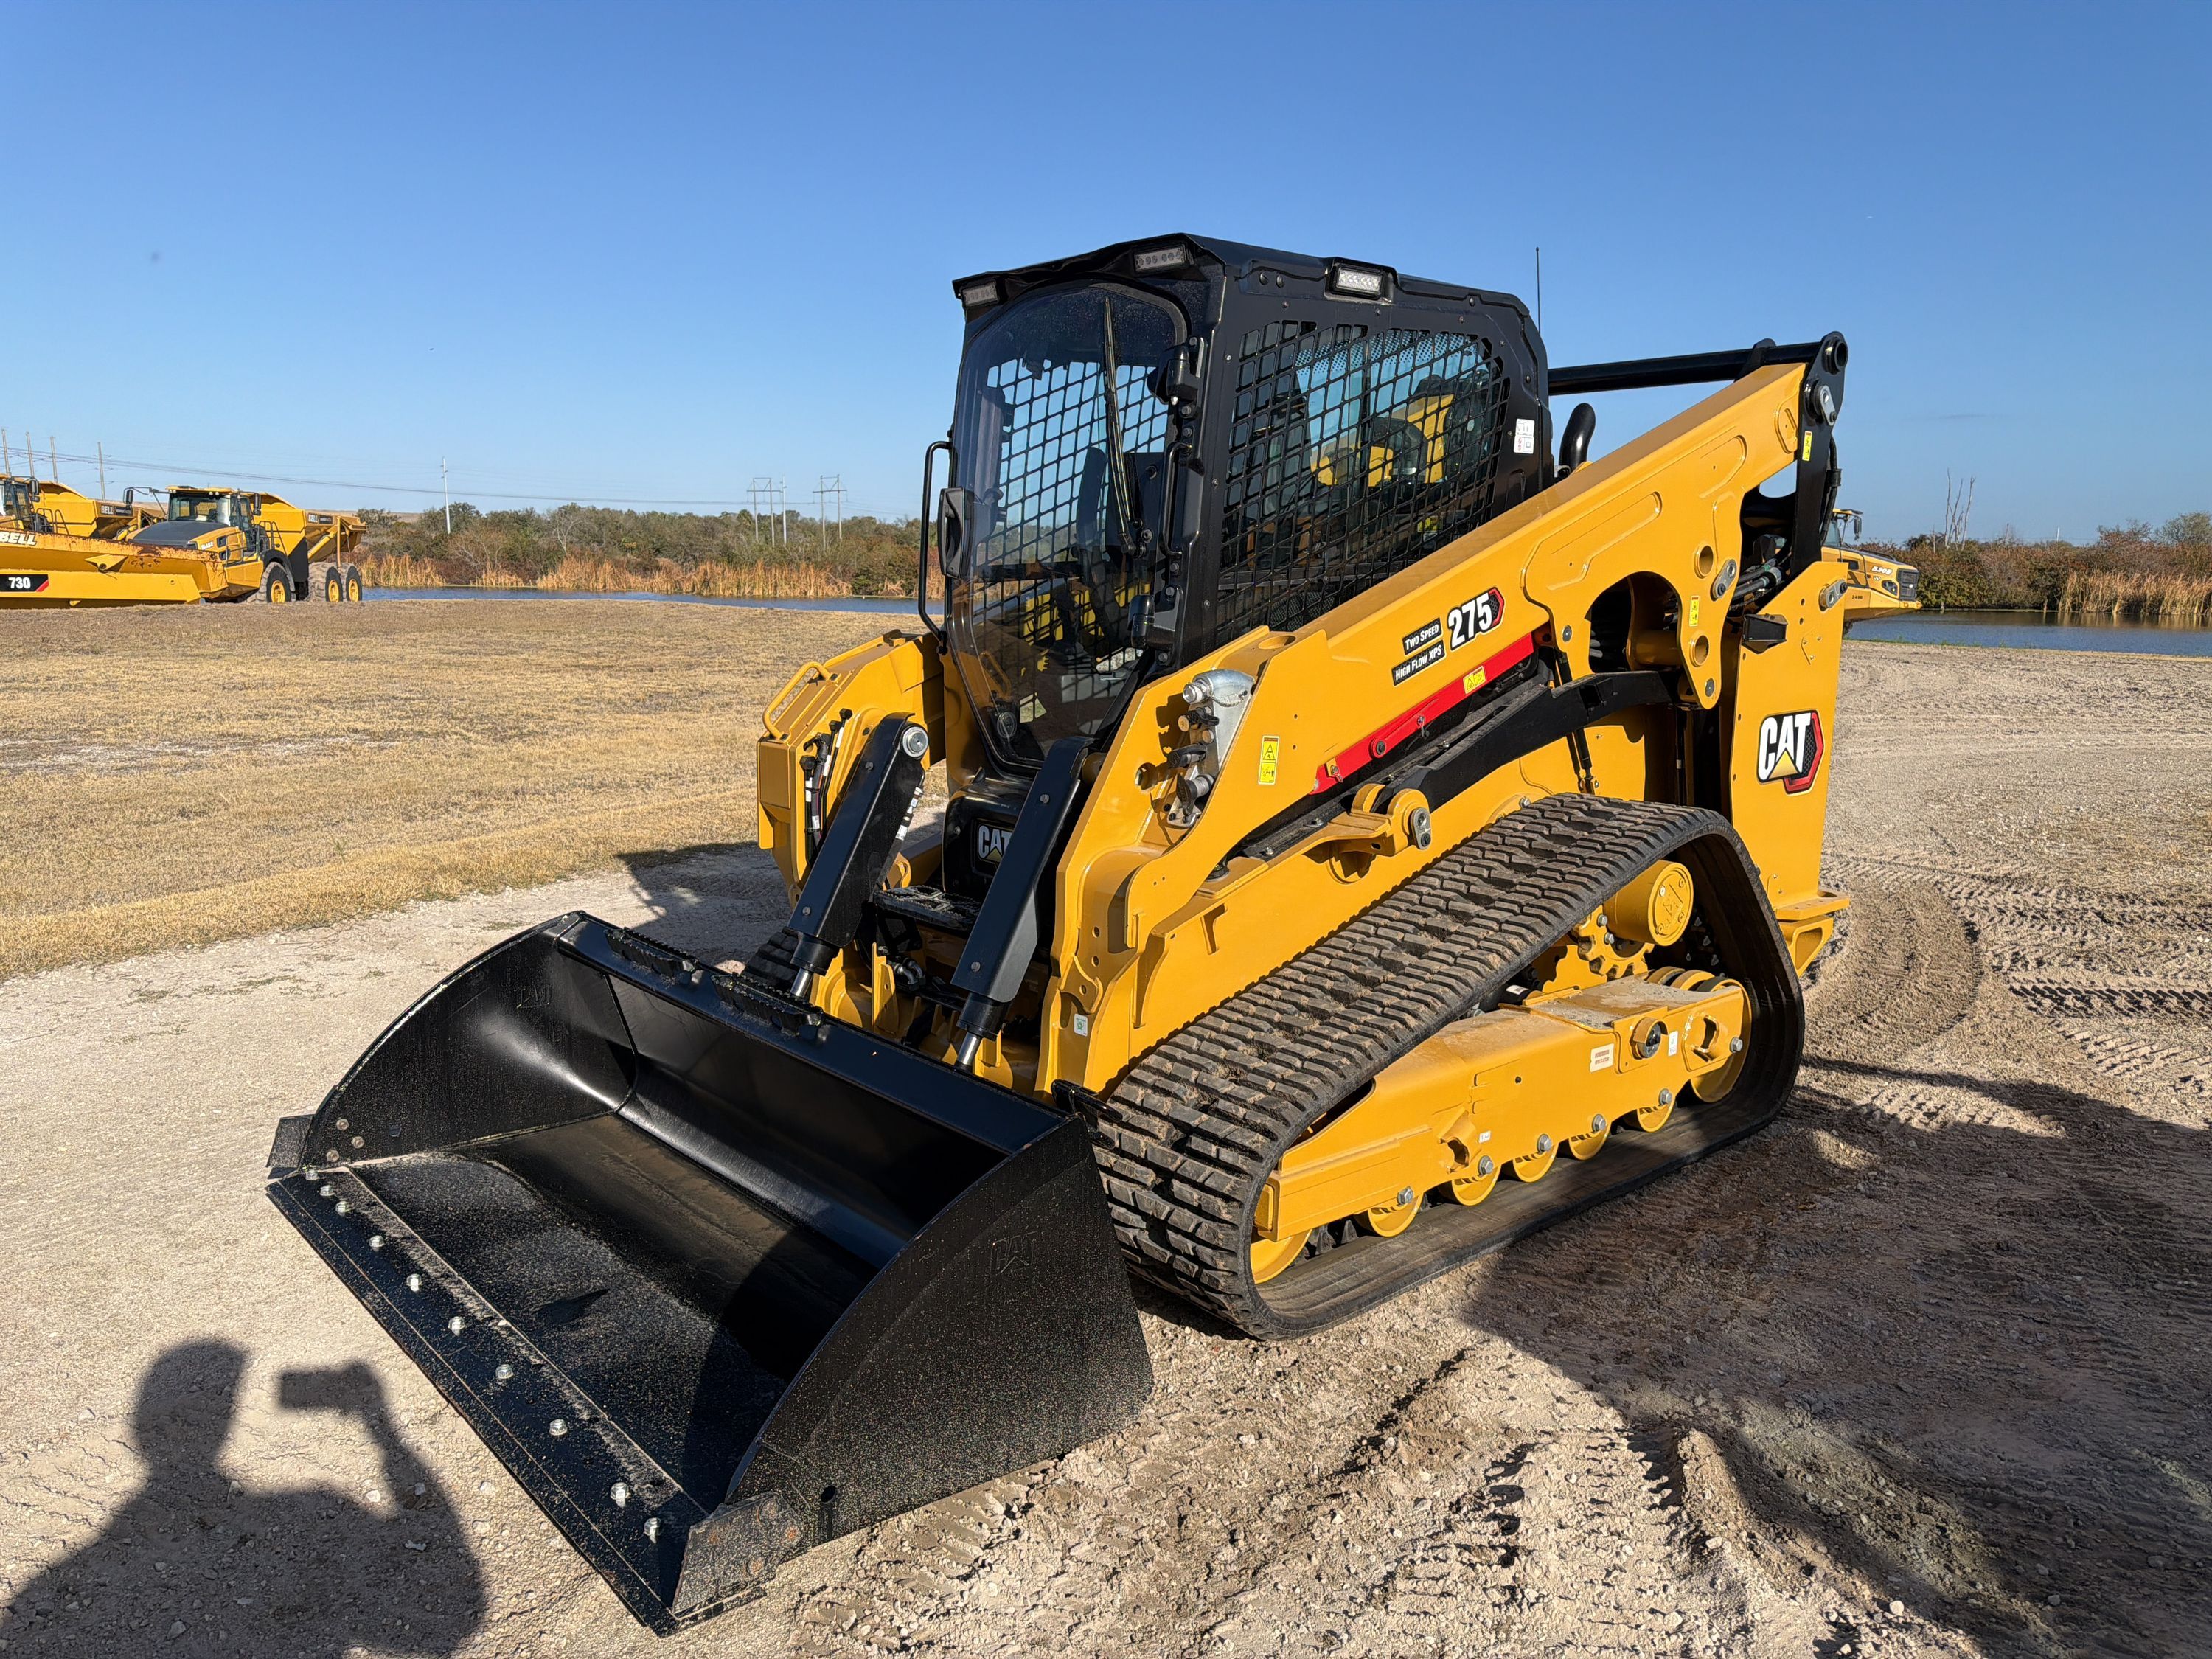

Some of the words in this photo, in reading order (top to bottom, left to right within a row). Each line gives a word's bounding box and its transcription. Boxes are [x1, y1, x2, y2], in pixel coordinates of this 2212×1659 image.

[0, 531, 37, 546] BELL
[8, 577, 31, 589] 730
[1448, 592, 1492, 648] 275
[1428, 644, 1442, 661] XPS
[1758, 712, 1812, 780] CAT
[978, 825, 1013, 860] CAT
